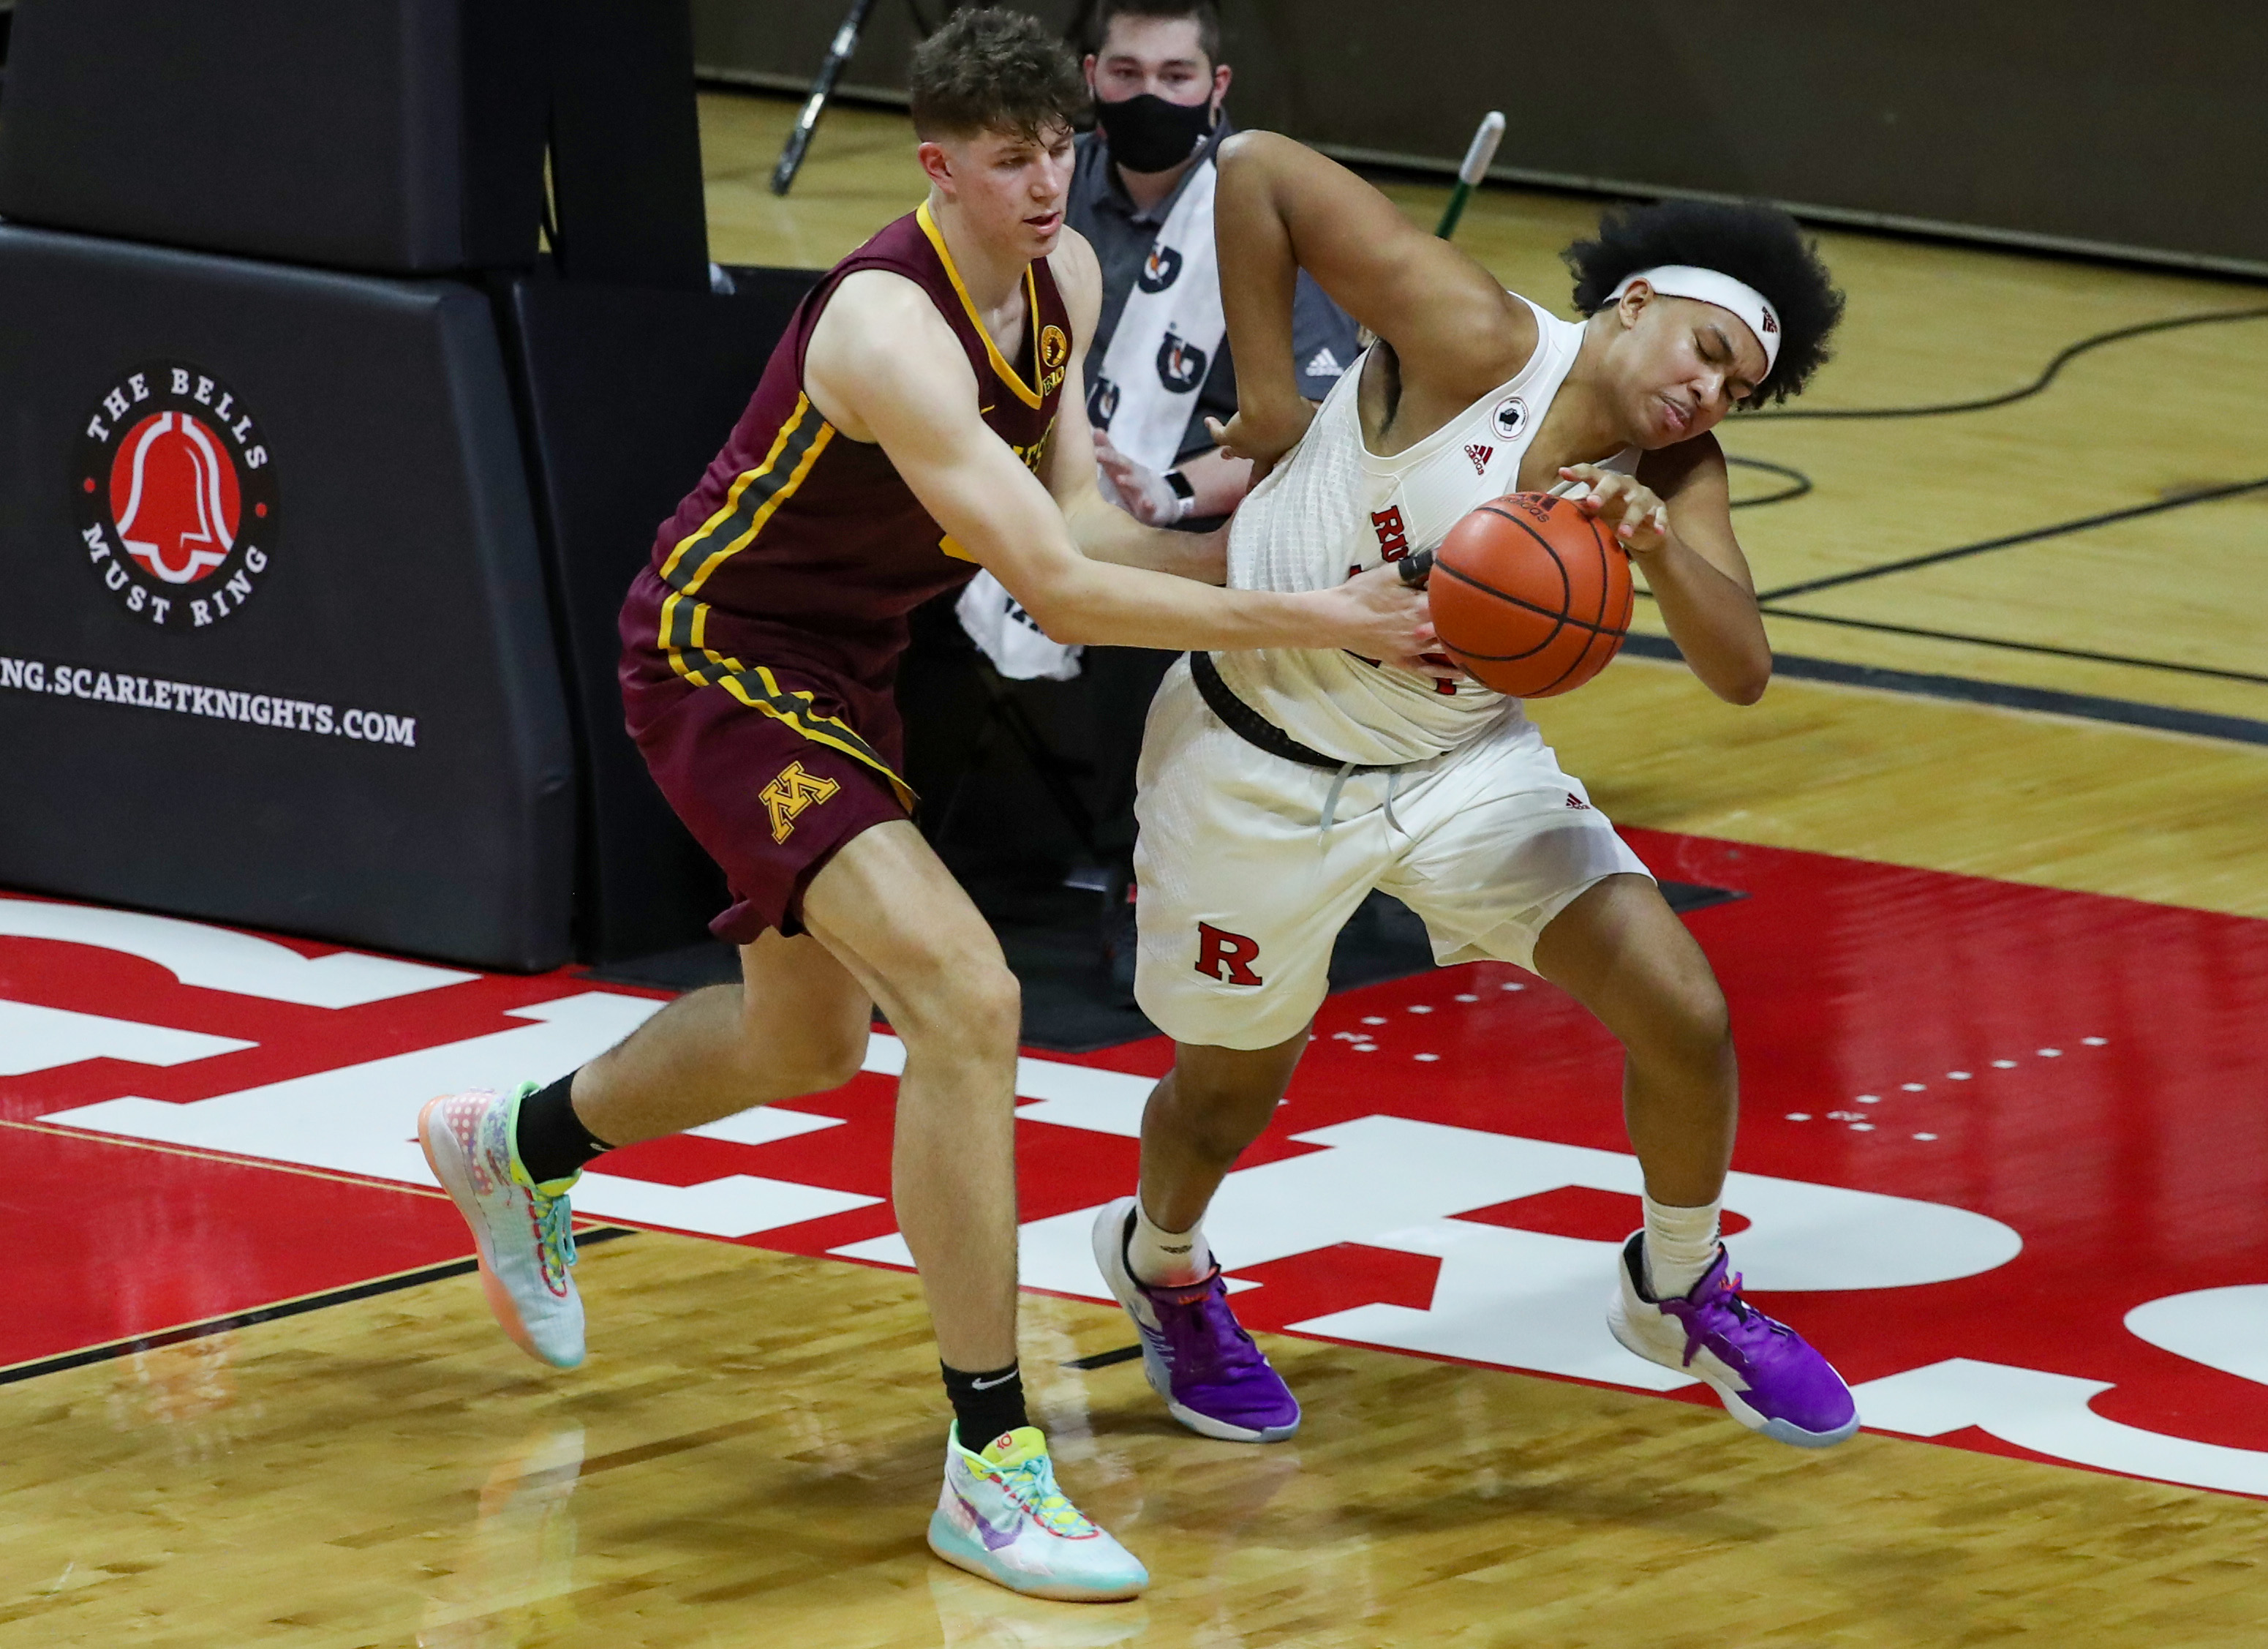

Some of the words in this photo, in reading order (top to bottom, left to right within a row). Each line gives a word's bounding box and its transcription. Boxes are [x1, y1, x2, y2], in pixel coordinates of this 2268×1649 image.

[87, 373, 149, 442] THE
[171, 368, 268, 470] BELLS
[82, 522, 170, 625] MUST
[190, 546, 268, 627] RING
[0, 657, 416, 747] NG.SCARLETKNIGHTS.COM
[758, 761, 840, 844] M
[1194, 921, 1262, 986] R
